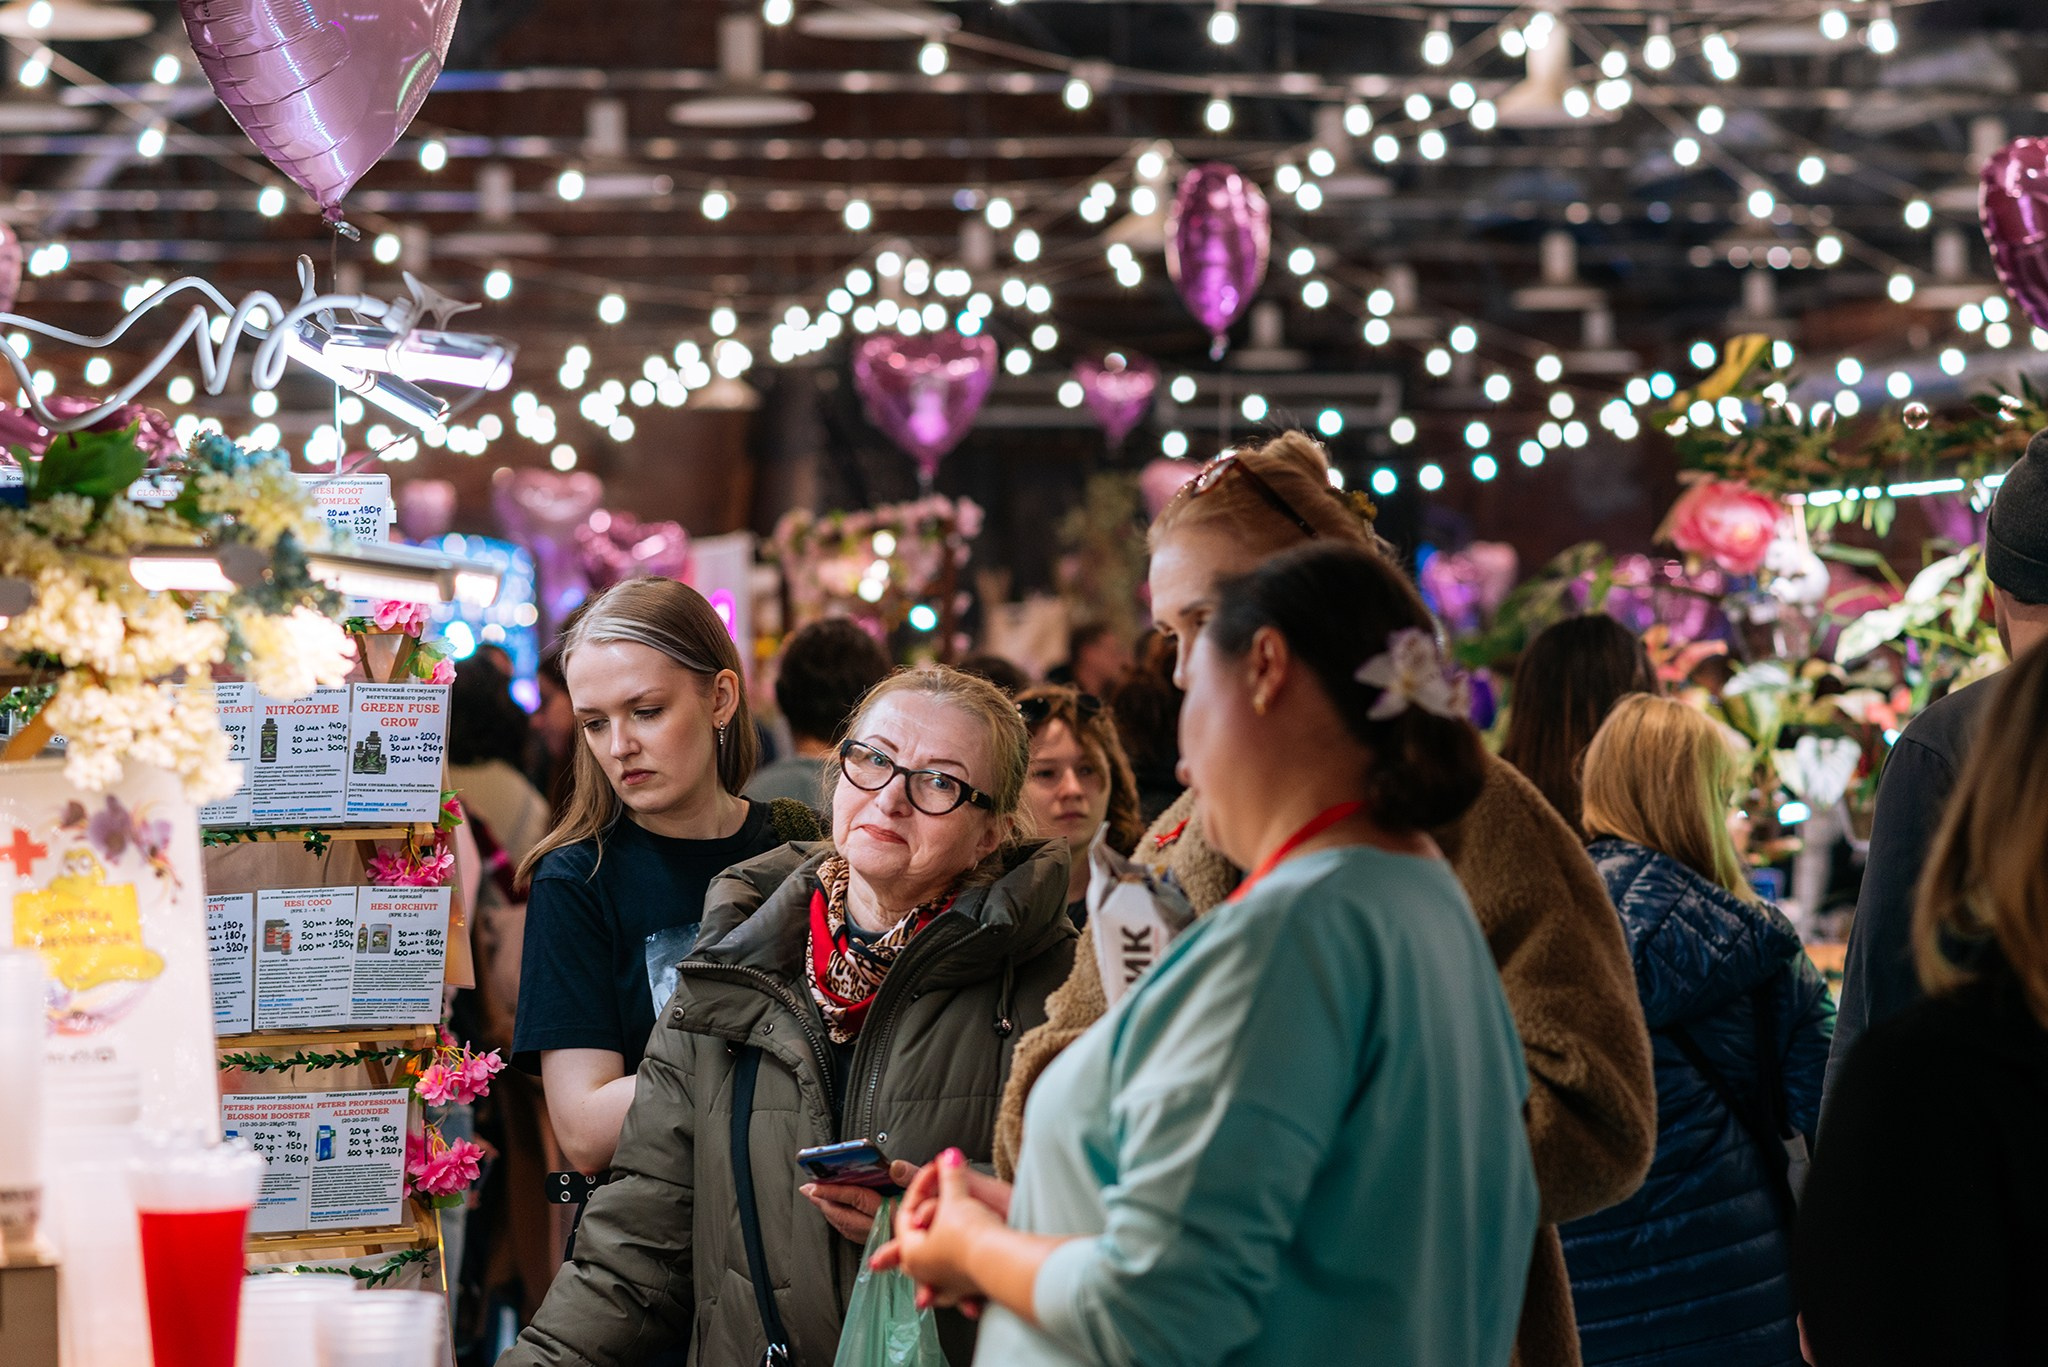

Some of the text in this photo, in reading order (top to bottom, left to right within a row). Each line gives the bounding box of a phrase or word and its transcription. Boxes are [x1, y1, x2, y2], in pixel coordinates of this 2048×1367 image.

[223, 706, 254, 714] START
[265, 704, 340, 716] NITROZYME
[360, 702, 440, 714] GREEN FUSE
[380, 718, 419, 727] GROW
[294, 724, 305, 732] 10
[292, 736, 302, 744] 20
[389, 734, 399, 742] 20
[390, 756, 400, 764] 50
[208, 895, 243, 903] удобрение
[284, 898, 332, 908] HESI COCO
[208, 904, 226, 912] TNT
[303, 920, 314, 928] 30
[301, 932, 314, 940] 50
[298, 944, 314, 952] 100
[394, 948, 408, 956] 100
[348, 1098, 406, 1107] PROFESSIONAL
[333, 1108, 390, 1117] ALLROUNDER
[254, 1132, 265, 1140] 20
[349, 1128, 361, 1136] 20
[349, 1138, 360, 1146] 50
